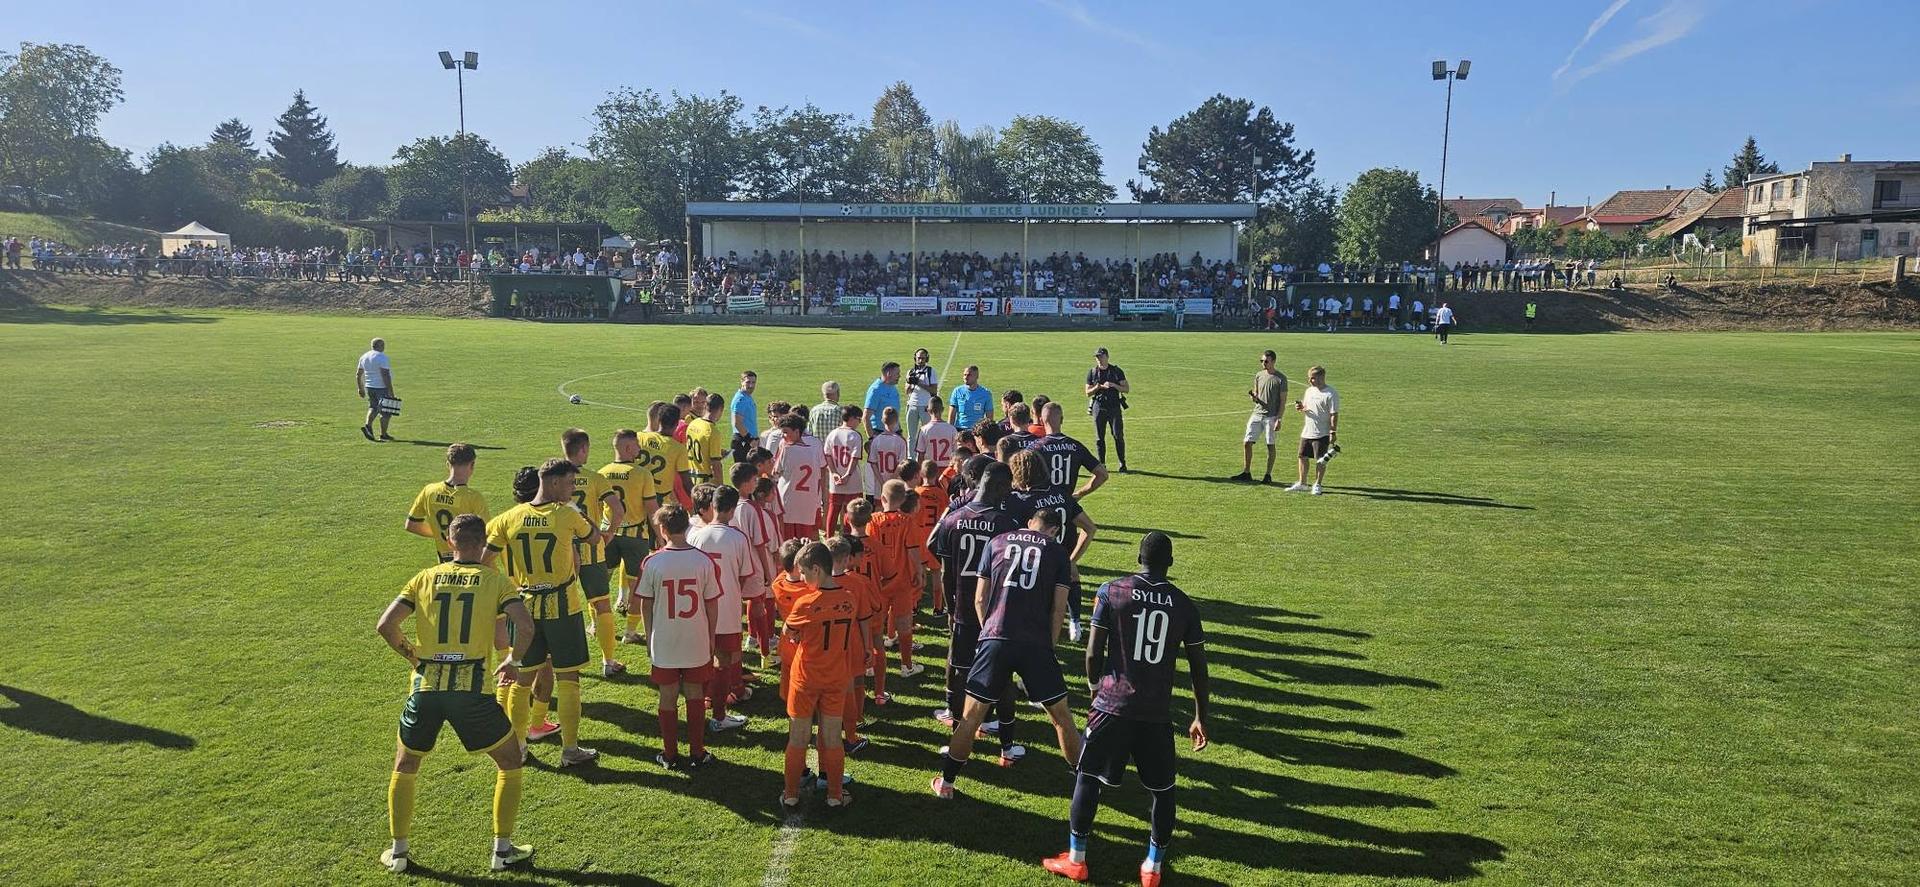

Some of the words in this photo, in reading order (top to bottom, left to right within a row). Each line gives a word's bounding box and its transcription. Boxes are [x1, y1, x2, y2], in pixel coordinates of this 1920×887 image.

[858, 206, 872, 215] TJ
[1031, 206, 1089, 216] LUDINCE
[959, 302, 992, 311] TIPS
[878, 451, 898, 473] 10
[930, 438, 950, 461] 12
[795, 464, 812, 492] 2
[1051, 453, 1072, 485] 81
[957, 519, 995, 532] FALLOU
[1007, 533, 1047, 546] GAGUA
[516, 532, 557, 575] 17
[960, 533, 991, 577] 27
[1003, 544, 1041, 590] 29
[434, 574, 480, 586] DOMASTA
[662, 578, 699, 619] 15
[1132, 588, 1173, 607] SYLLA
[433, 592, 475, 644] 11
[823, 618, 851, 650] 17
[1132, 607, 1169, 664] 19
